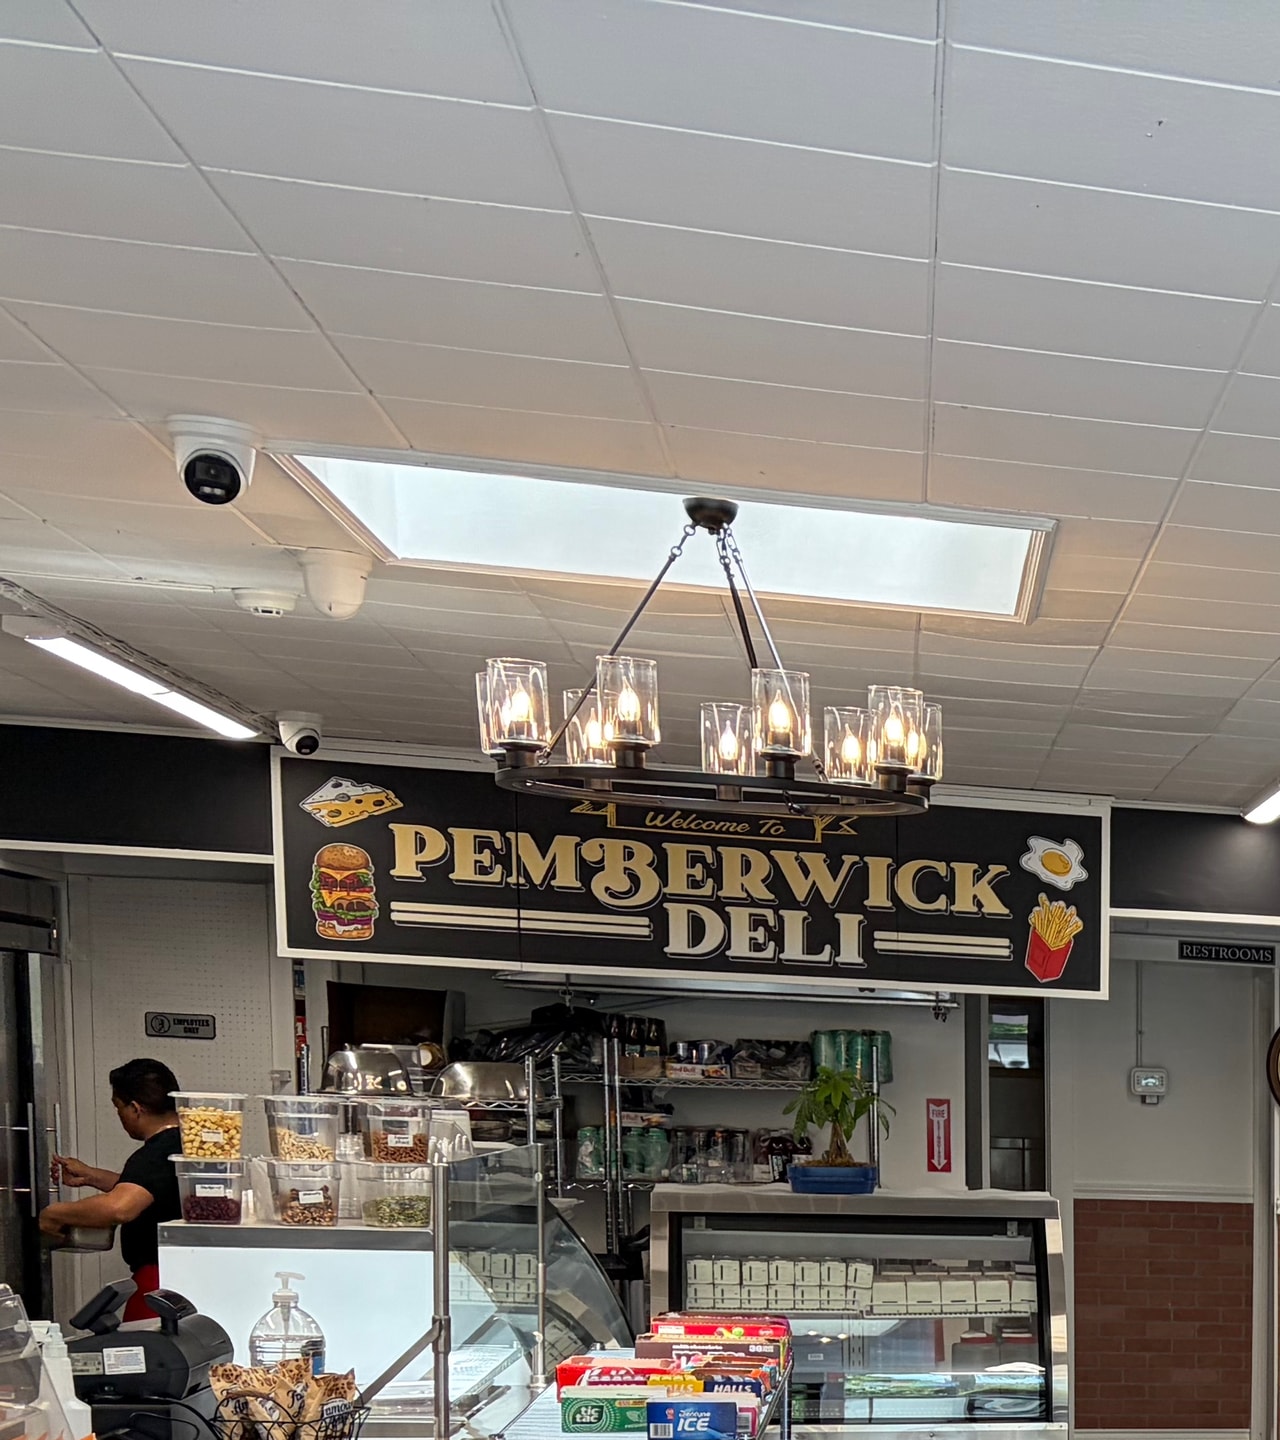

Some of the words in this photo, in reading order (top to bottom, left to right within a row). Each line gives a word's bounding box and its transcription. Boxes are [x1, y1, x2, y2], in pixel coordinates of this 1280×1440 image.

[644, 810, 751, 834] Welcome
[758, 819, 787, 836] To
[389, 823, 1013, 919] PEMBERWICK
[662, 902, 868, 968] DELI
[1182, 944, 1272, 962] RESTROOMS
[713, 1384, 752, 1393] HALLS
[575, 1412, 599, 1423] tac
[580, 1406, 602, 1416] tic
[677, 1418, 711, 1432] ICE
